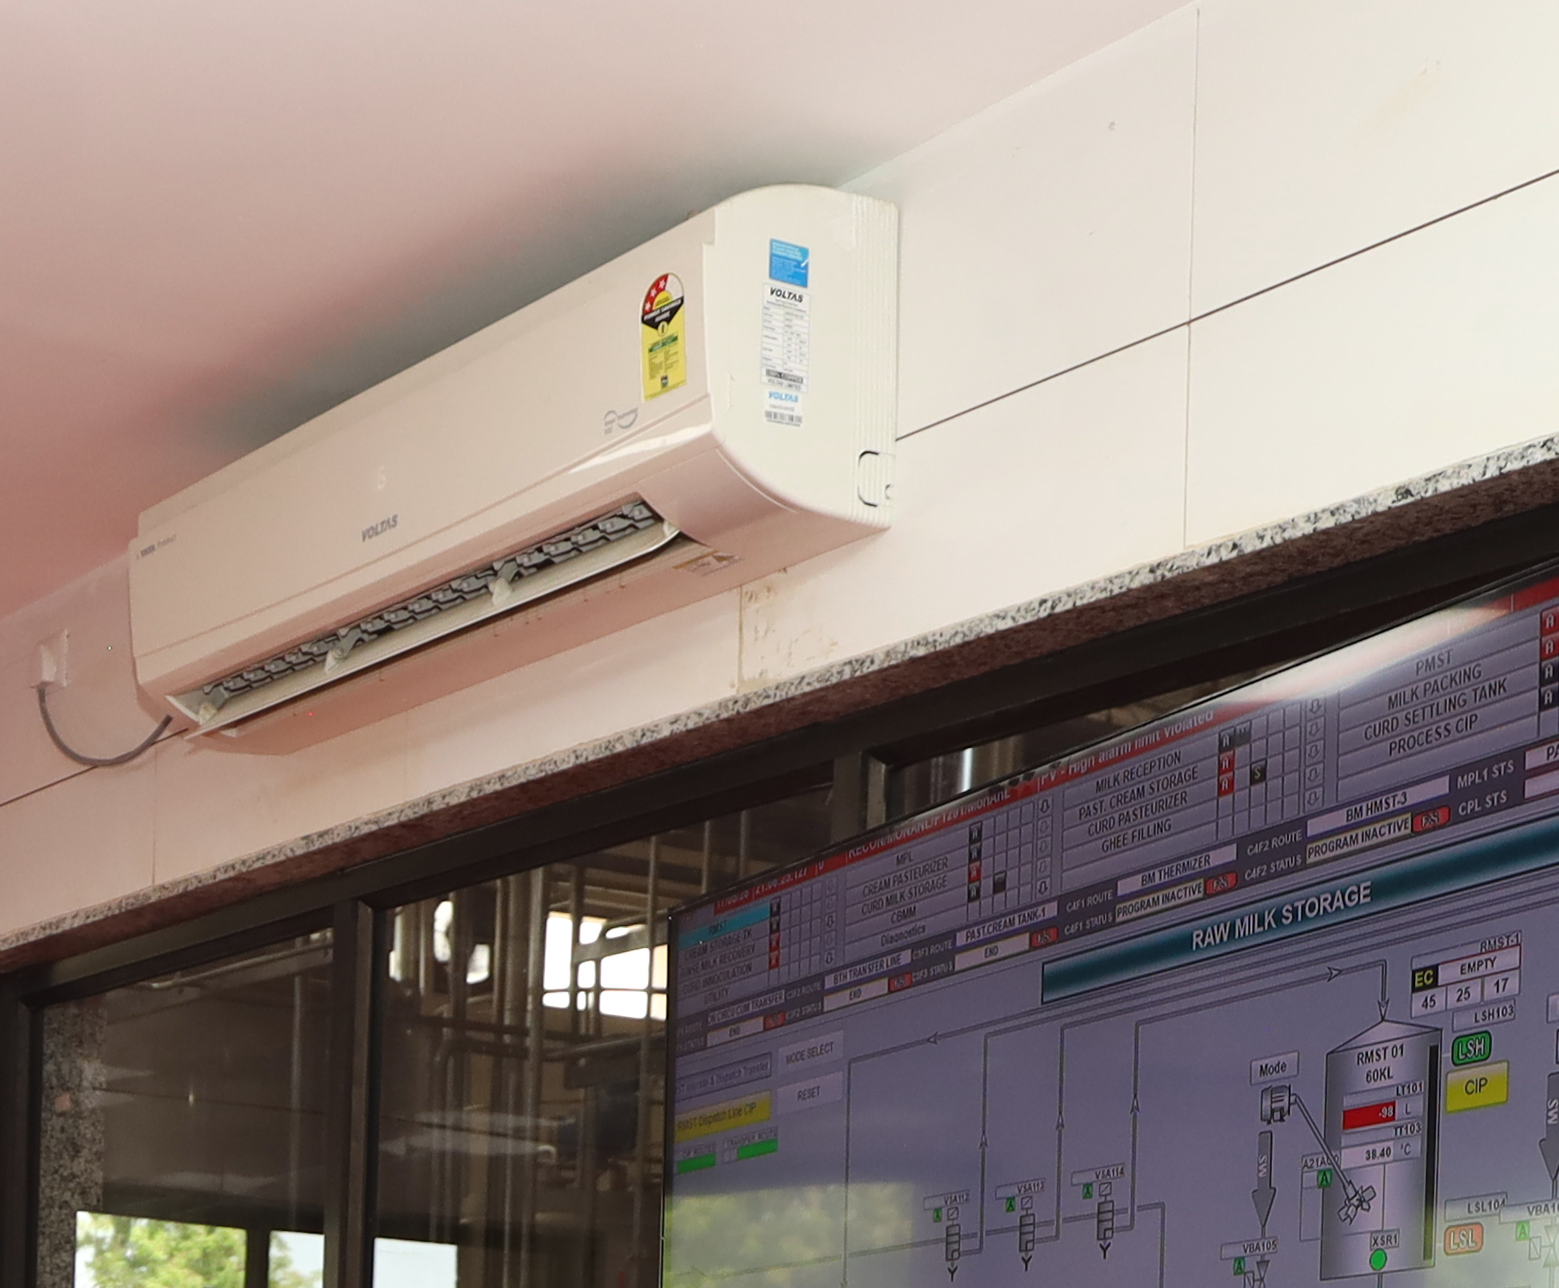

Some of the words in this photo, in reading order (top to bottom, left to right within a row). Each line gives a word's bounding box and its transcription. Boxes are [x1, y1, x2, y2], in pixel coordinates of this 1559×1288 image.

[770, 287, 803, 303] VOLTAS
[769, 391, 799, 403] VOLTAS
[361, 514, 398, 542] VOLTAS
[1415, 649, 1453, 676] PMST
[1388, 683, 1419, 709] MILK
[1423, 663, 1482, 698] PACKING
[1364, 715, 1400, 741] CURD
[1404, 694, 1468, 728] SETTLING
[1470, 678, 1508, 706] TANK
[1389, 724, 1452, 757] PROCESS
[1455, 714, 1479, 737] CIP
[1095, 772, 1121, 794] MILK
[1123, 750, 1182, 781] RECEPTION
[1087, 814, 1116, 837] CURD
[1118, 791, 1188, 828] PASTEURIZER
[1101, 833, 1129, 853] GHEE
[1131, 819, 1172, 845] FILLING
[1308, 833, 1359, 859] PROGRAM
[1361, 817, 1410, 844] INACTIVE
[862, 877, 891, 898] CREAM
[892, 856, 949, 887] PASTEURIZER
[1192, 919, 1231, 951] RAW
[1235, 909, 1277, 941] MILK
[1281, 881, 1372, 927] STORAGE
[1459, 956, 1497, 975] EMPTY
[1414, 969, 1434, 987] EC
[1473, 1005, 1515, 1023] LSH103
[1357, 1048, 1389, 1066] RMST
[1391, 1043, 1405, 1059] 01
[1459, 1038, 1486, 1061] LSH
[1259, 1061, 1287, 1077] Mode
[1365, 1065, 1394, 1081] 60KL
[1464, 1078, 1489, 1095] CIP
[1242, 1241, 1278, 1254] VBA105
[1371, 1232, 1399, 1247] XSR1
[1450, 1229, 1478, 1249] LSL
